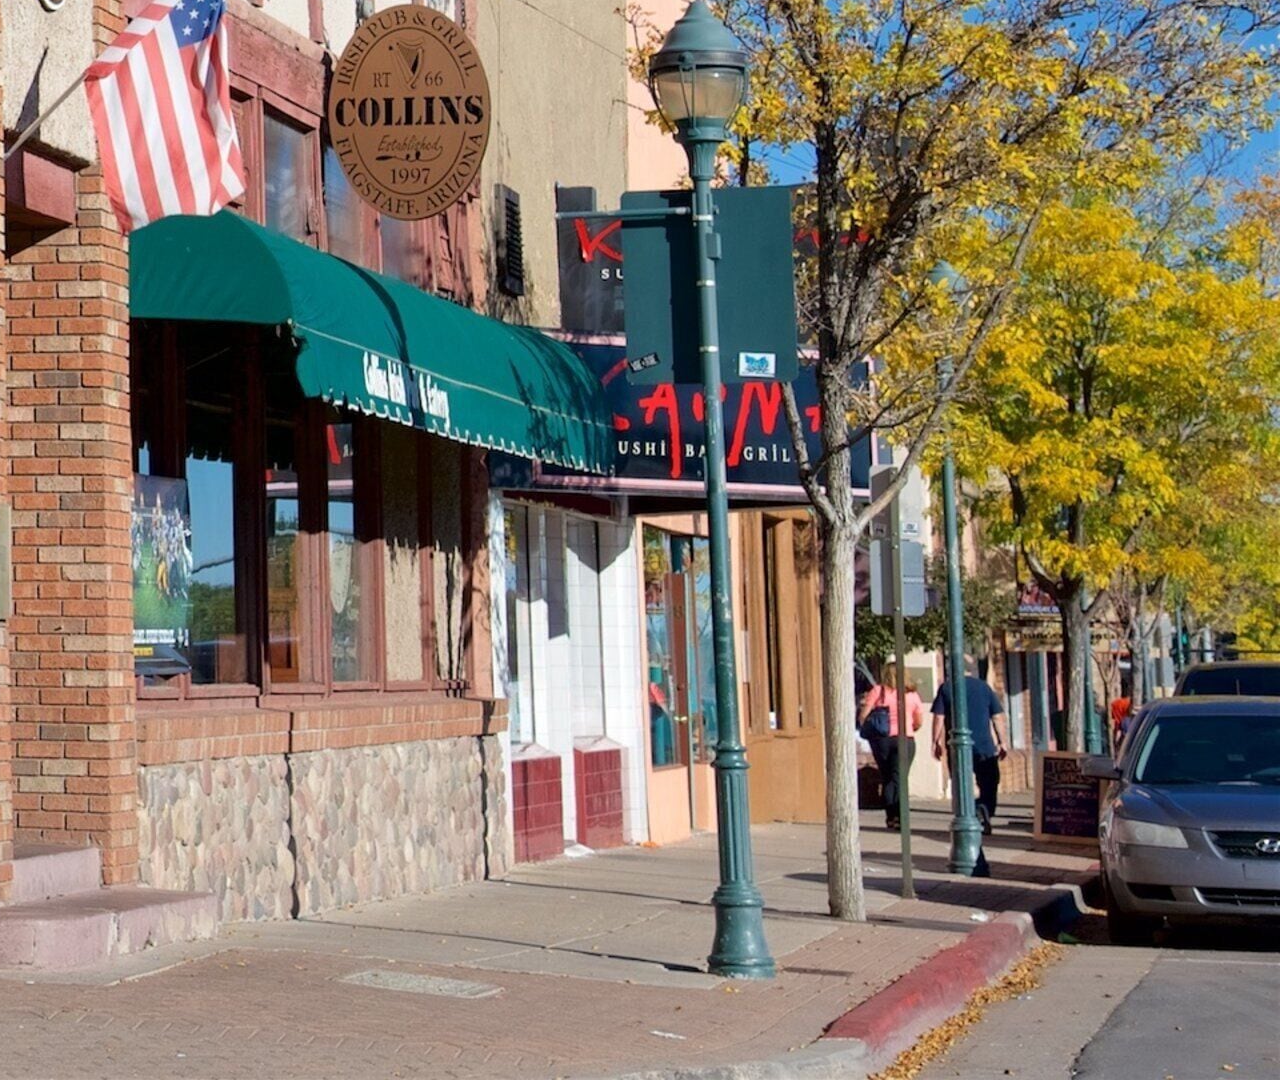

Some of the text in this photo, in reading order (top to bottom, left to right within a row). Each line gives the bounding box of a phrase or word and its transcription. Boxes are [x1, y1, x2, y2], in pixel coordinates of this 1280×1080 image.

[336, 9, 479, 87] IRISH PUB & GRILL
[372, 71, 445, 88] RT 66
[334, 94, 485, 127] COLLINS
[335, 132, 484, 216] FLAGSTAFF, ARIZONA
[390, 167, 432, 185] 1997
[617, 439, 667, 457] USHI
